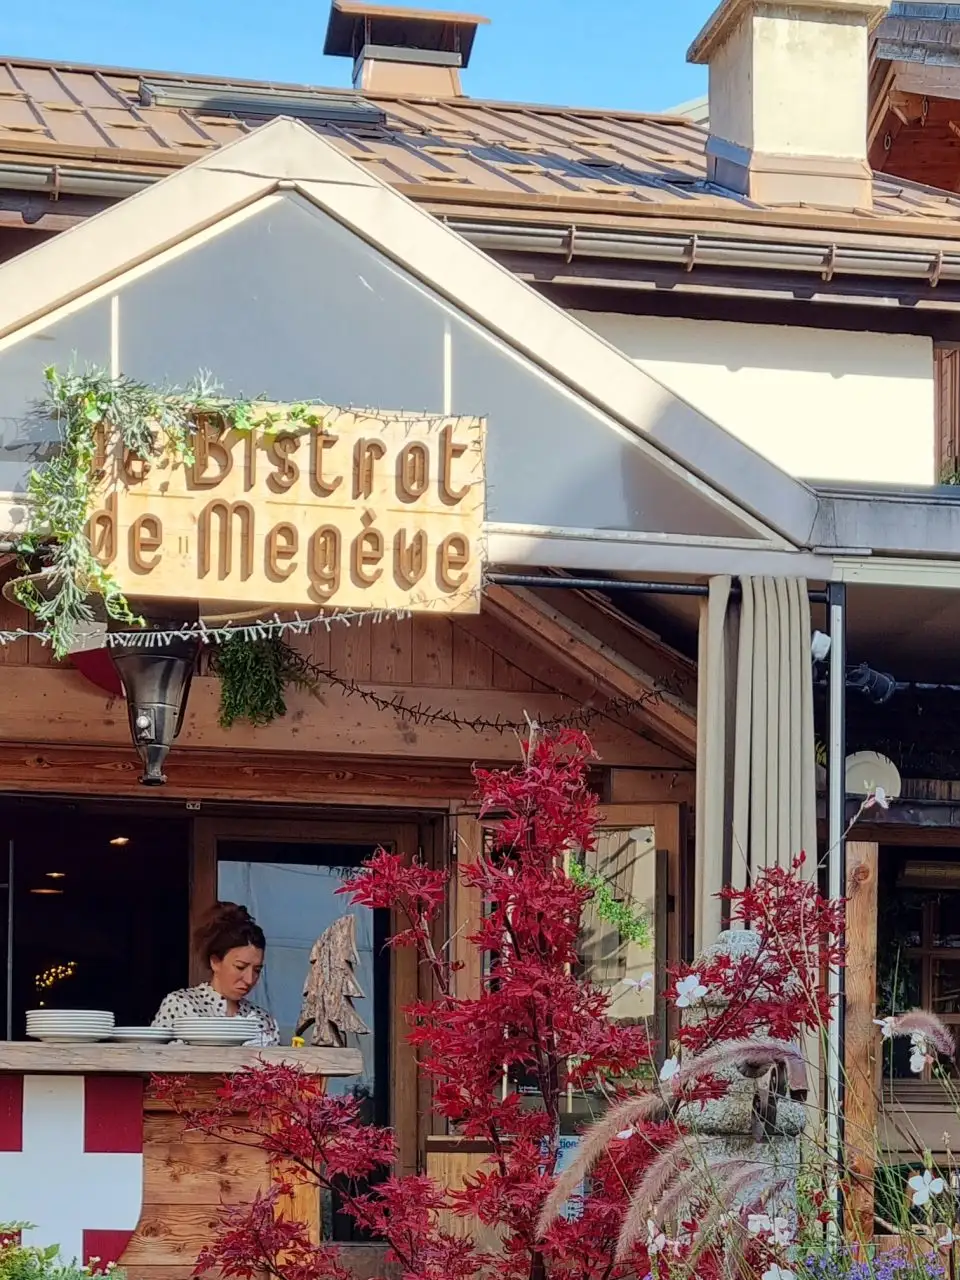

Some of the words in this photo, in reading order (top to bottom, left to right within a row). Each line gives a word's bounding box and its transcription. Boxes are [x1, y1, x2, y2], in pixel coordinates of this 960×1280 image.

[188, 409, 473, 503] Bistrot
[87, 491, 163, 572] de
[200, 498, 471, 600] Megève
